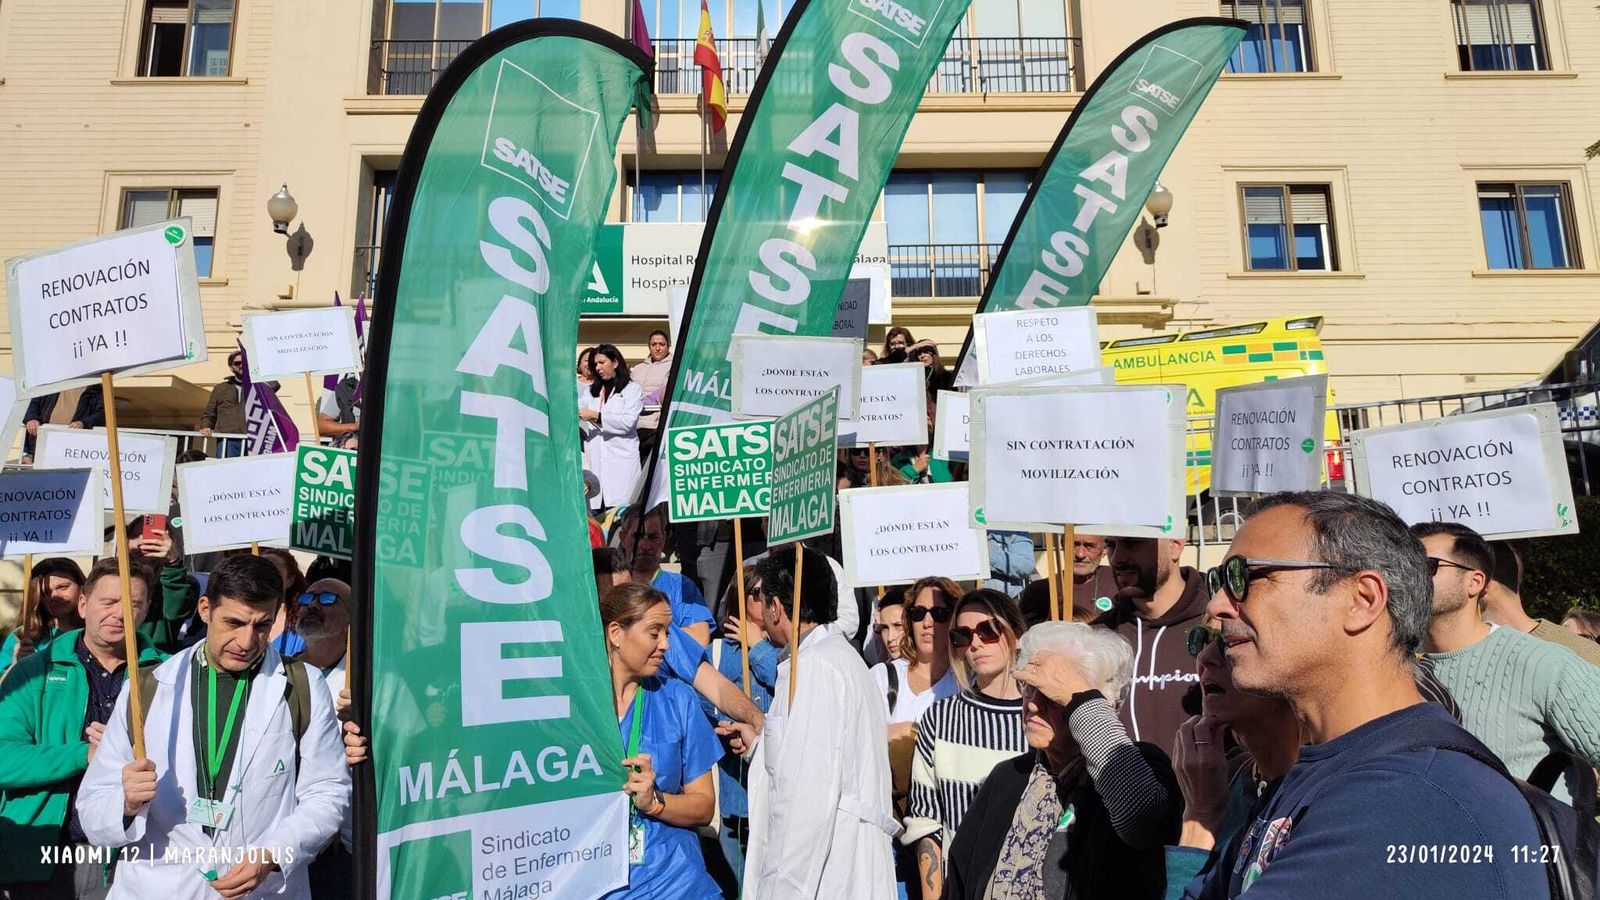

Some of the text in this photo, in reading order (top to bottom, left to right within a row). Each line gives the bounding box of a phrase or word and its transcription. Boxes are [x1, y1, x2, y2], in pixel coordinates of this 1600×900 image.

[1136, 78, 1180, 109] SATSE
[492, 136, 570, 204] SATSE
[1015, 105, 1158, 310] SATSE
[631, 254, 682, 267] Hospital
[853, 253, 886, 263] álaga
[41, 258, 150, 299] RENOVACIÓN
[586, 296, 618, 304] Andalucía
[49, 293, 149, 329] CONTRATOS
[1016, 317, 1059, 328] RESPETO
[88, 334, 108, 352] YA
[1026, 333, 1053, 343] A LOS
[1015, 349, 1067, 360] DERECHOS
[1114, 351, 1215, 369] AMBULANCIA
[800, 368, 829, 377] ESTÁN
[1015, 364, 1070, 376] LABORALES
[683, 369, 731, 400] MÁL
[755, 387, 825, 397] LOS CONTRATO
[1231, 407, 1296, 426] RENOVACIÓN
[775, 398, 835, 462] SATSE
[673, 424, 774, 461] SATS
[1006, 436, 1135, 451] SIN CONTRATACIÓN
[1231, 437, 1290, 451] CONTRATOS
[64, 448, 147, 463] RENOVCIÓN
[454, 196, 571, 728] SATSE
[1392, 439, 1513, 469] RENOVACIÓN
[674, 457, 766, 477] SINDICATO
[774, 444, 832, 484] SINDICATO DE
[1021, 466, 1120, 479] MOVILIZACIÓN
[1251, 463, 1260, 477] YA
[675, 471, 772, 492] ENFERMER
[773, 468, 831, 503] ENFERMERIA
[1402, 470, 1512, 495] CONTRATOS
[676, 487, 772, 517] MALAG
[0, 509, 72, 523] ONTRATOS
[204, 508, 290, 524] LOS CONTRATOS?
[771, 492, 829, 538] MALAGA
[1448, 504, 1471, 520] YA
[23, 531, 39, 541] YA
[870, 543, 958, 556] LOS CONTRATOS?
[399, 744, 603, 807] MÁLAGA
[482, 826, 571, 855] Sindicato
[482, 859, 507, 881] de
[514, 841, 613, 876] Enfermería
